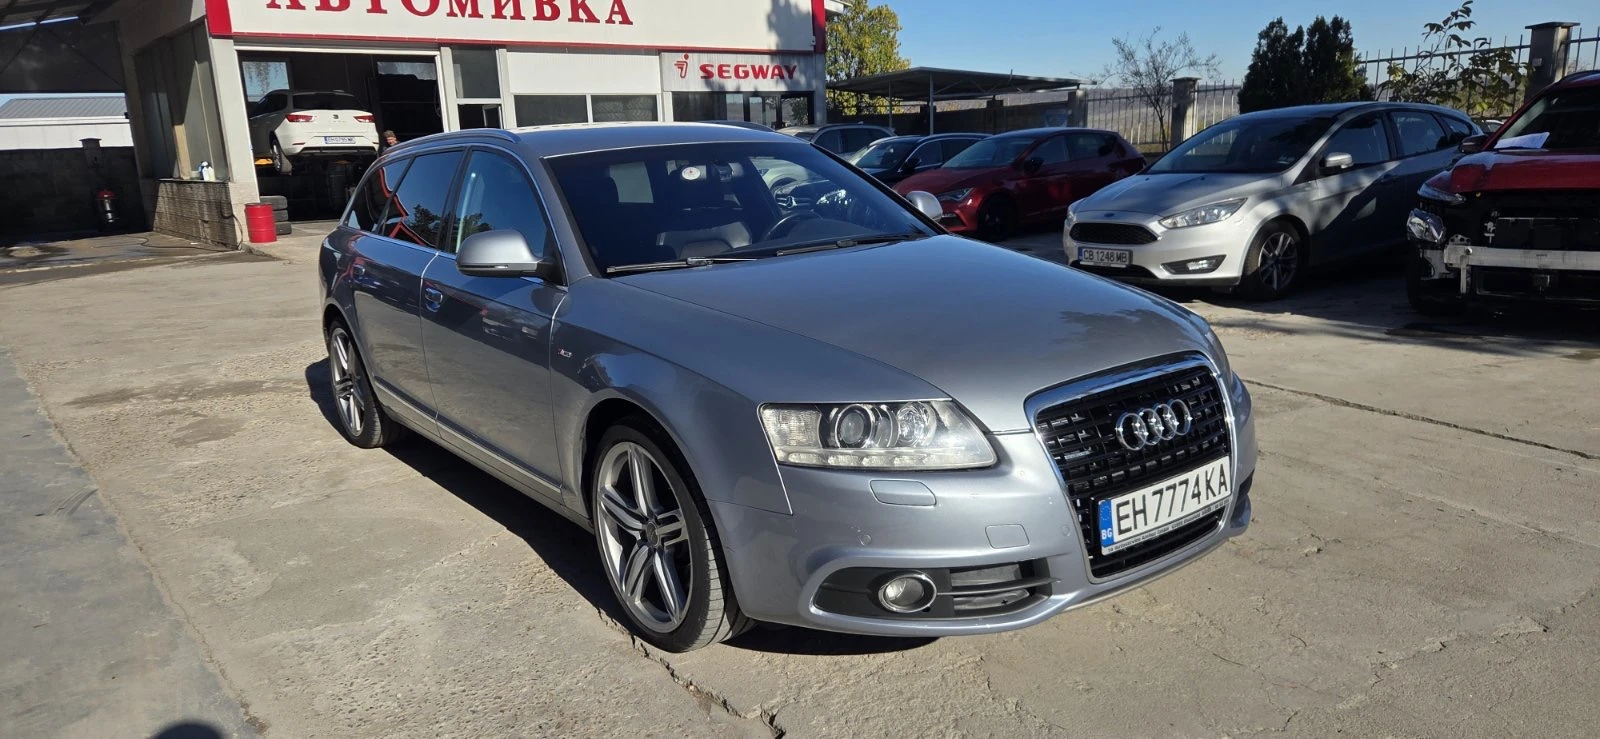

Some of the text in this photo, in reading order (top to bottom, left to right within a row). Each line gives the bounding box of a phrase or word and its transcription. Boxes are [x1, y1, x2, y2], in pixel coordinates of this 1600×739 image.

[265, 0, 634, 25] ОМИВКА
[699, 63, 797, 80] SEGWAY
[1084, 250, 1094, 261] CB
[1115, 494, 1148, 536] EH
[1151, 473, 1202, 523] 7774
[1205, 463, 1228, 501] KA
[1101, 527, 1113, 540] BG
